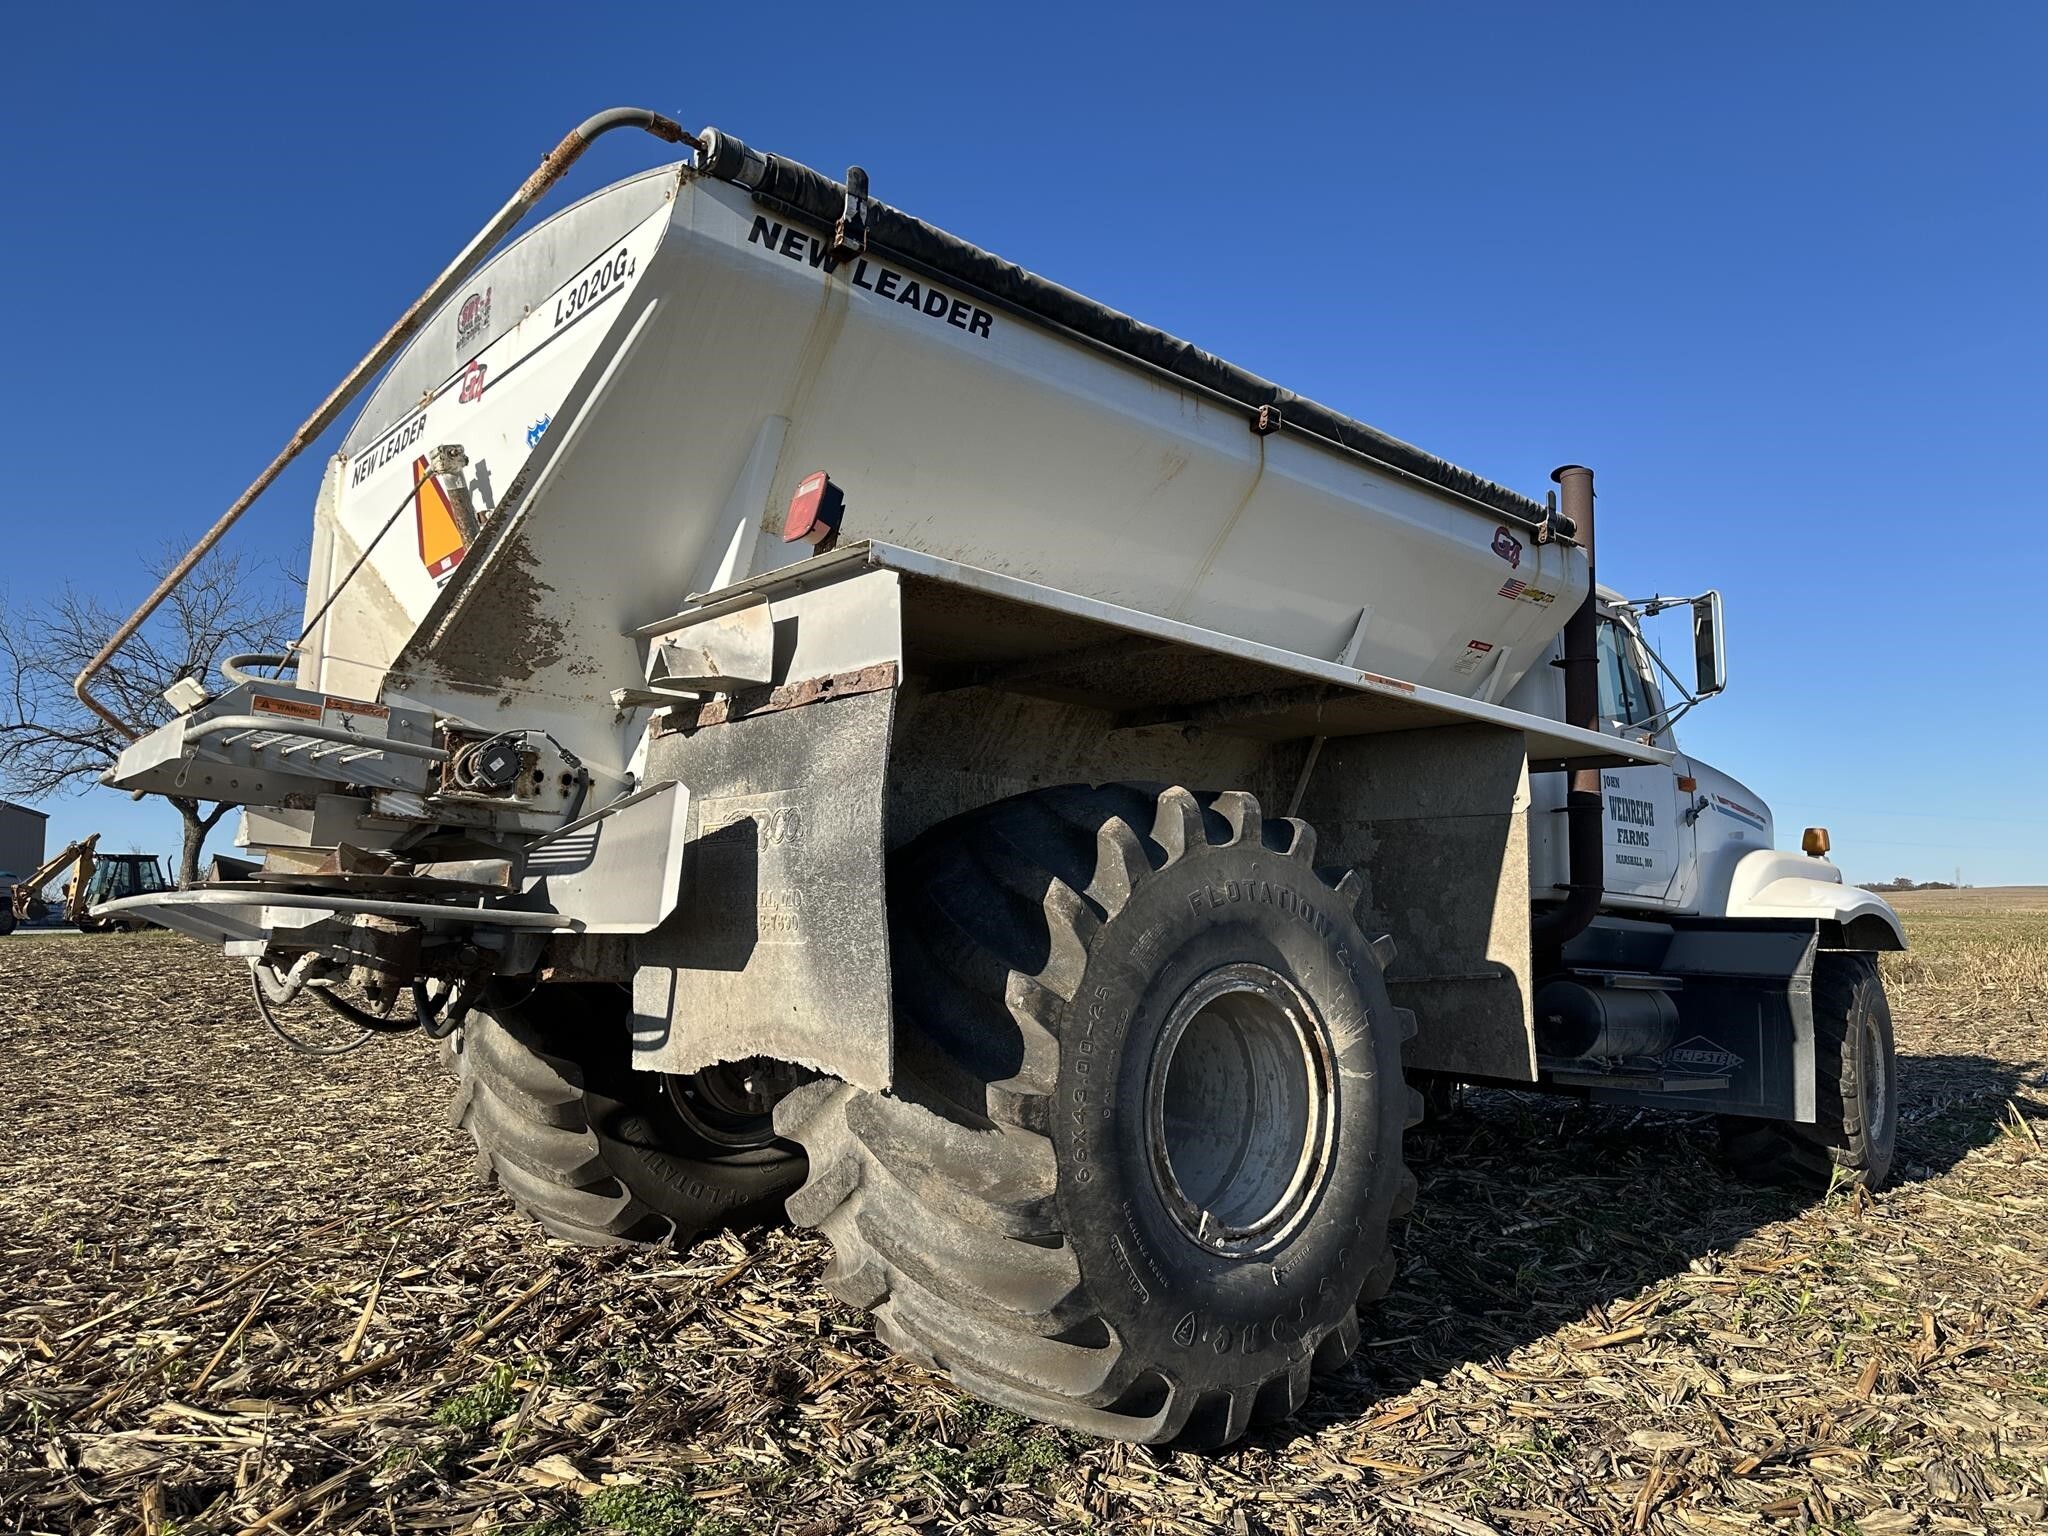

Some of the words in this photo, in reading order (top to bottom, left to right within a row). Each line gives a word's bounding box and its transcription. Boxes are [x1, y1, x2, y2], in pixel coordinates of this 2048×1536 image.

[748, 215, 839, 274] NEW
[852, 259, 993, 339] LEADER
[352, 457, 377, 489] NEW
[379, 413, 427, 468] LEADER
[1603, 775, 1620, 790] JOHN
[1608, 795, 1655, 827] WEINREICH
[1617, 828, 1650, 847] FARMS
[1615, 854, 1645, 869] MARSHALL,
[1187, 878, 1330, 938] FLOTATION
[1072, 984, 1112, 1184] 66X43.00-25
